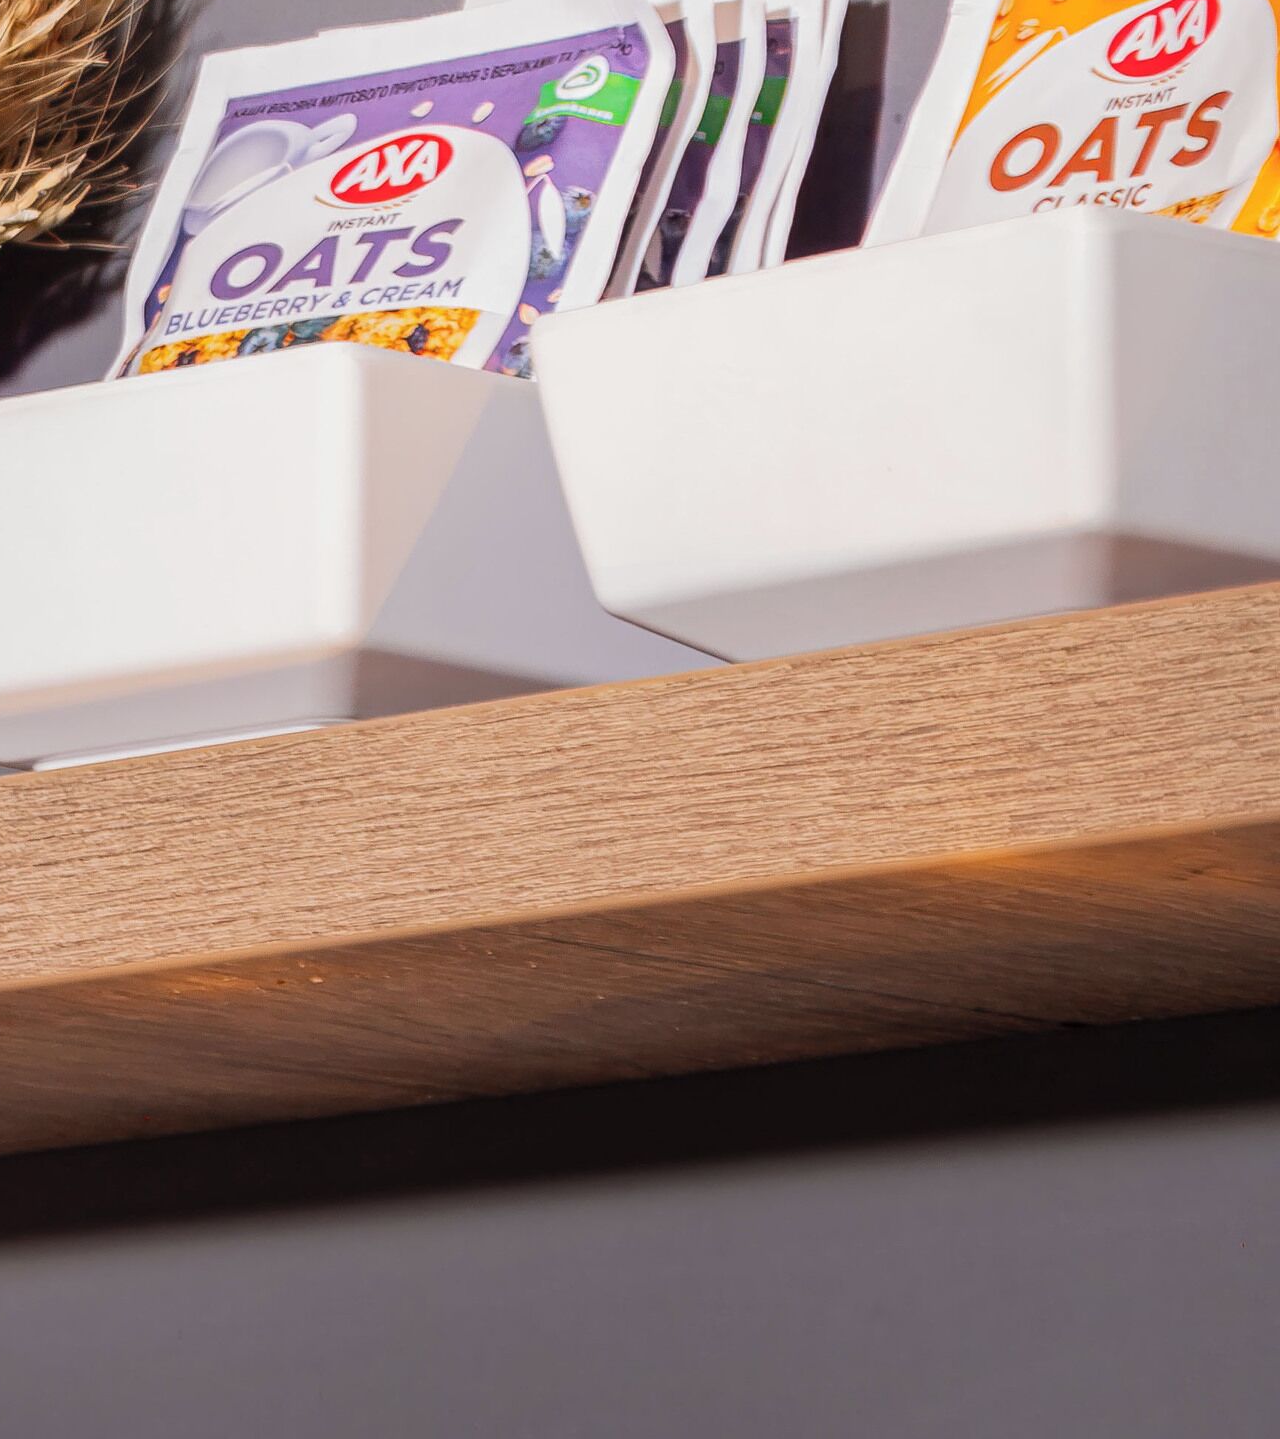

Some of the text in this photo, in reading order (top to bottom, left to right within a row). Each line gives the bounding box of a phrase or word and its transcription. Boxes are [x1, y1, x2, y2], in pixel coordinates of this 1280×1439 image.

[1106, 87, 1177, 111] INSTANT
[334, 138, 442, 194] AXA
[990, 90, 1233, 192] OATS
[327, 213, 402, 233] INSTANT
[210, 217, 466, 301] OATS
[165, 276, 467, 336] BLUEBERRY & CREAM
